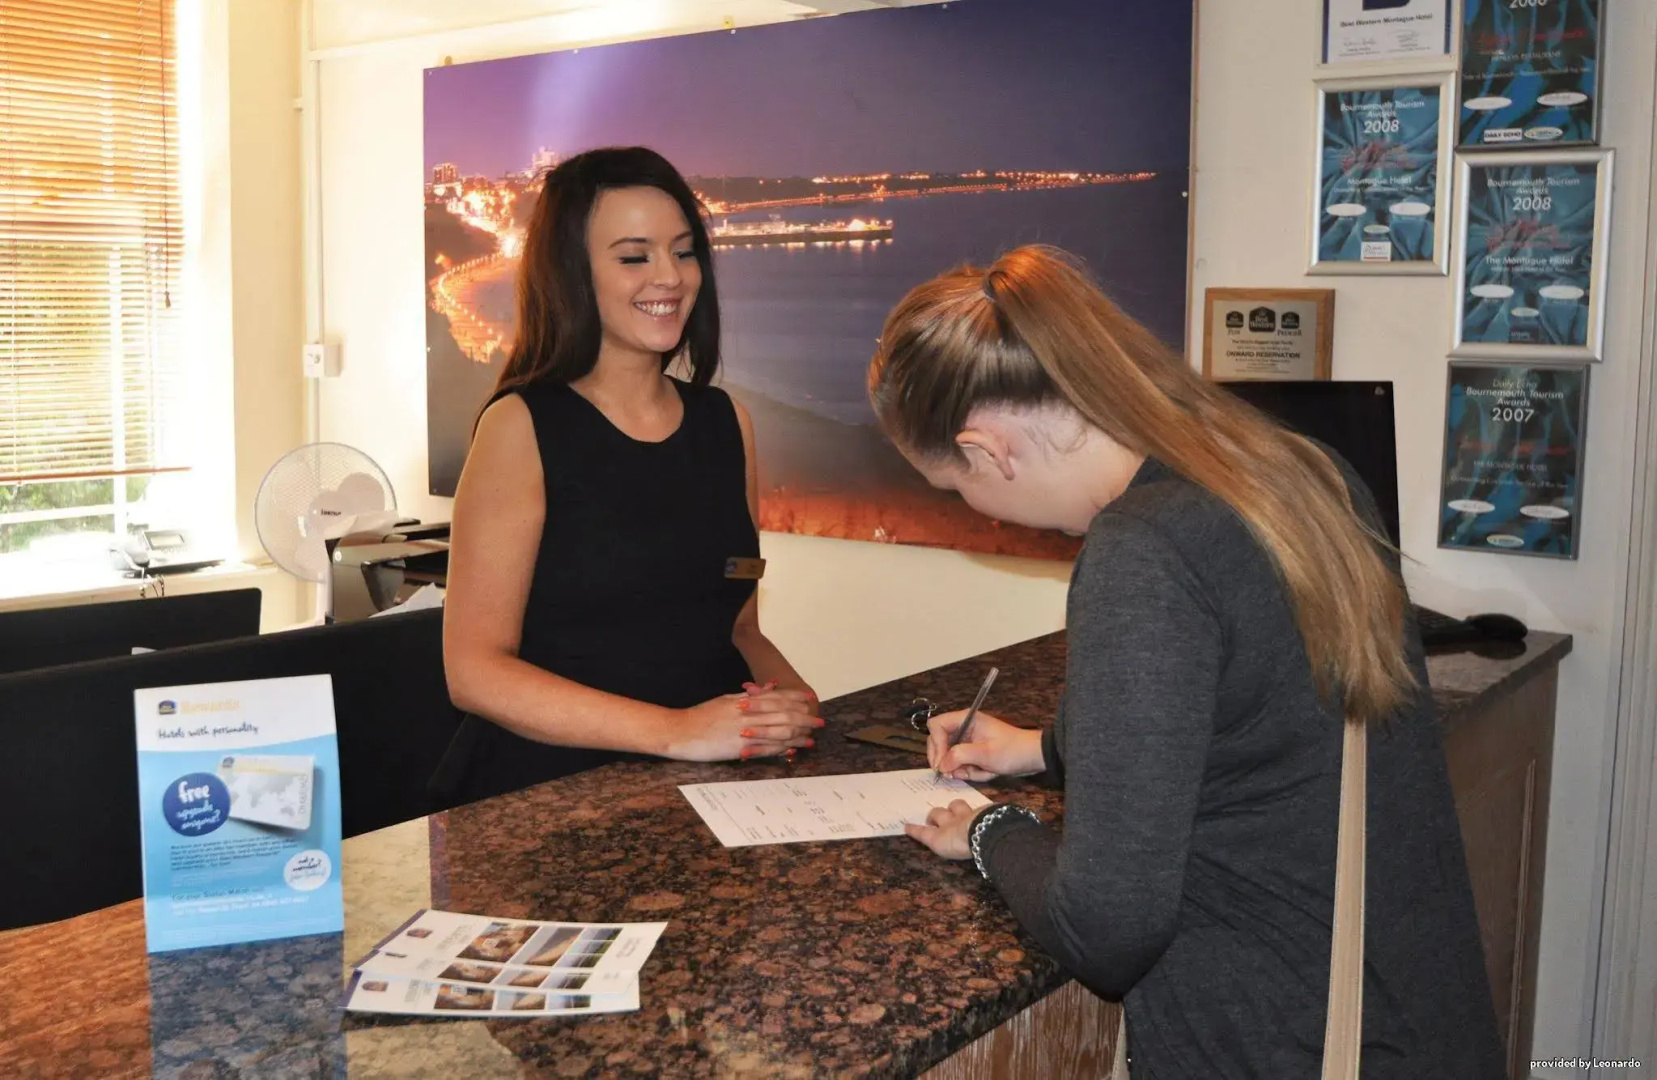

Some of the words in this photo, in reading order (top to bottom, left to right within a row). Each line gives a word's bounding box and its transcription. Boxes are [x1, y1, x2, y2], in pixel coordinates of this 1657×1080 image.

[1364, 119, 1400, 133] 2008
[1512, 196, 1552, 211] 2008
[1466, 386, 1526, 398] Bournemouth
[1529, 389, 1564, 399] Tourism
[1497, 398, 1531, 407] Awards
[1491, 407, 1535, 423] 2007
[158, 727, 185, 739] Hotels
[188, 725, 210, 738] with
[212, 720, 259, 738] personality
[178, 781, 211, 804] free
